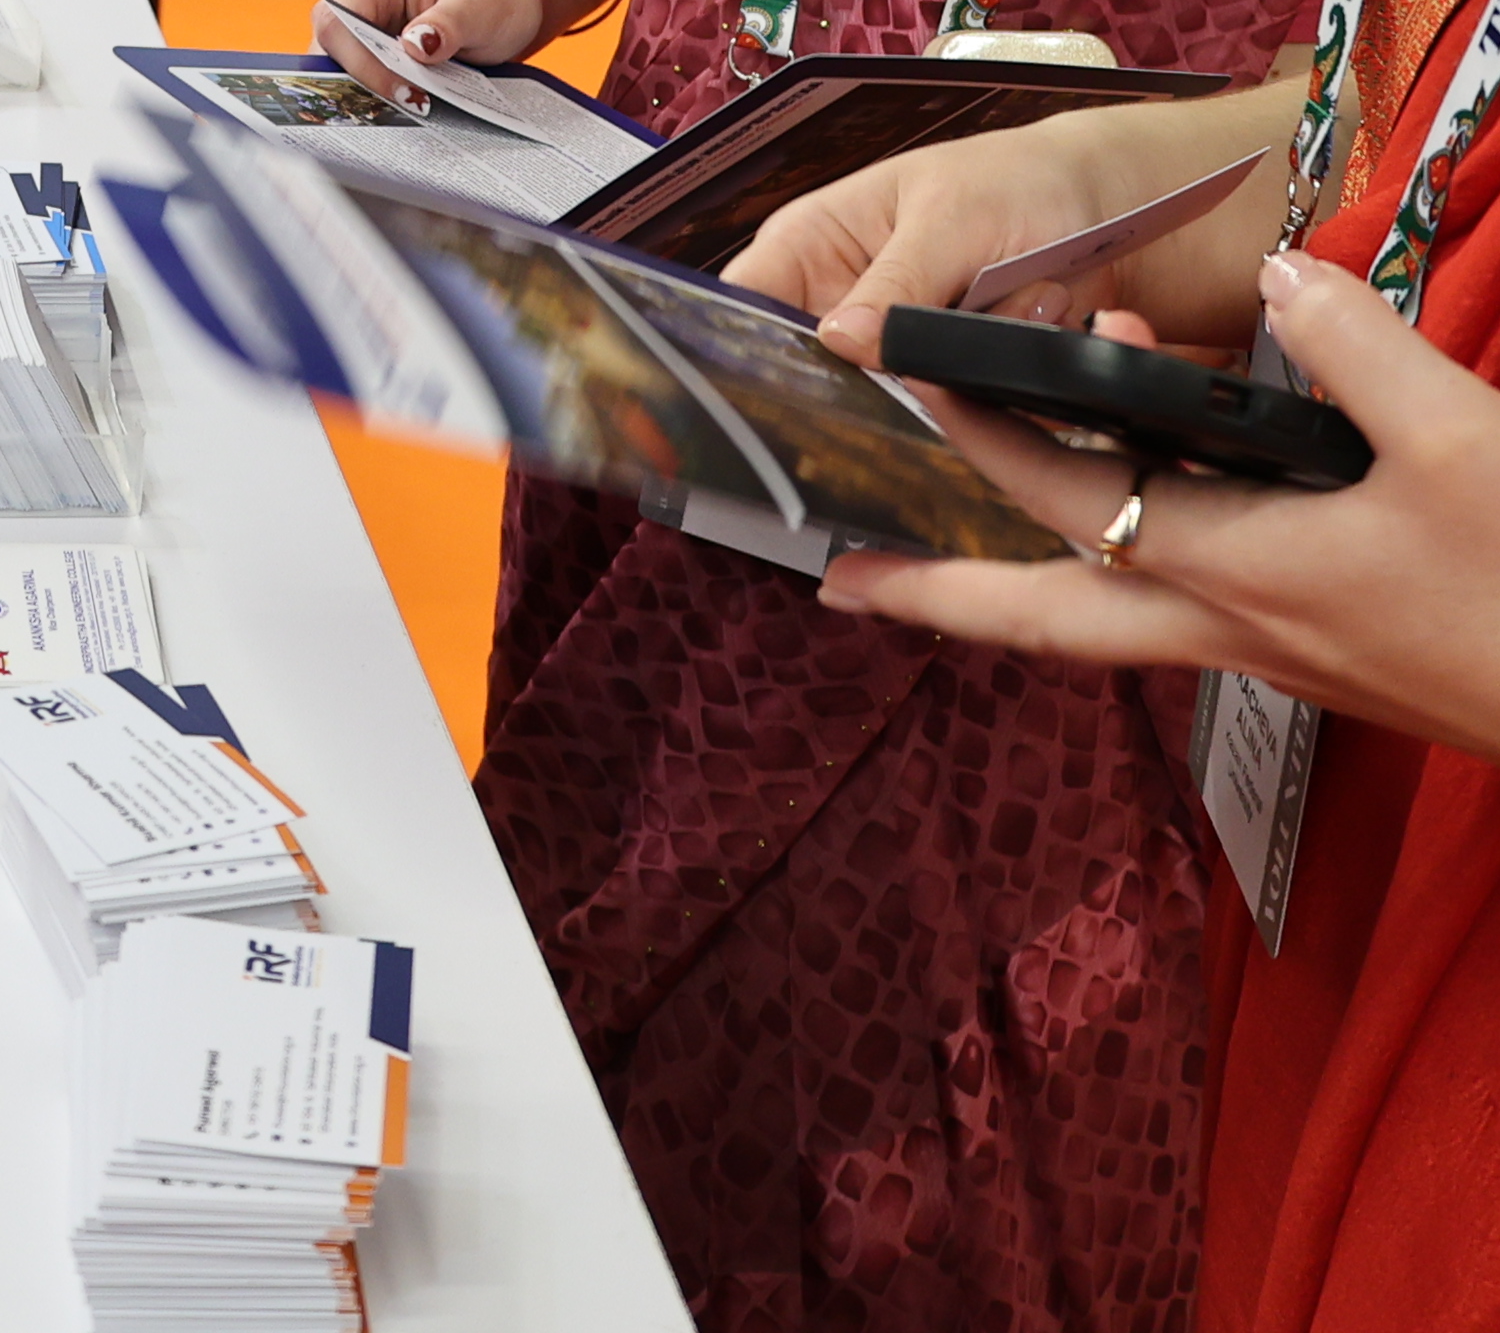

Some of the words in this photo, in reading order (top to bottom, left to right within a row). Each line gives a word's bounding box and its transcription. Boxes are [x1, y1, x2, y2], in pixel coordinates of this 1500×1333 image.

[62, 550, 77, 578] COLLEGE
[20, 569, 38, 606] AGARWAL
[26, 607, 45, 651] AKANKSHA
